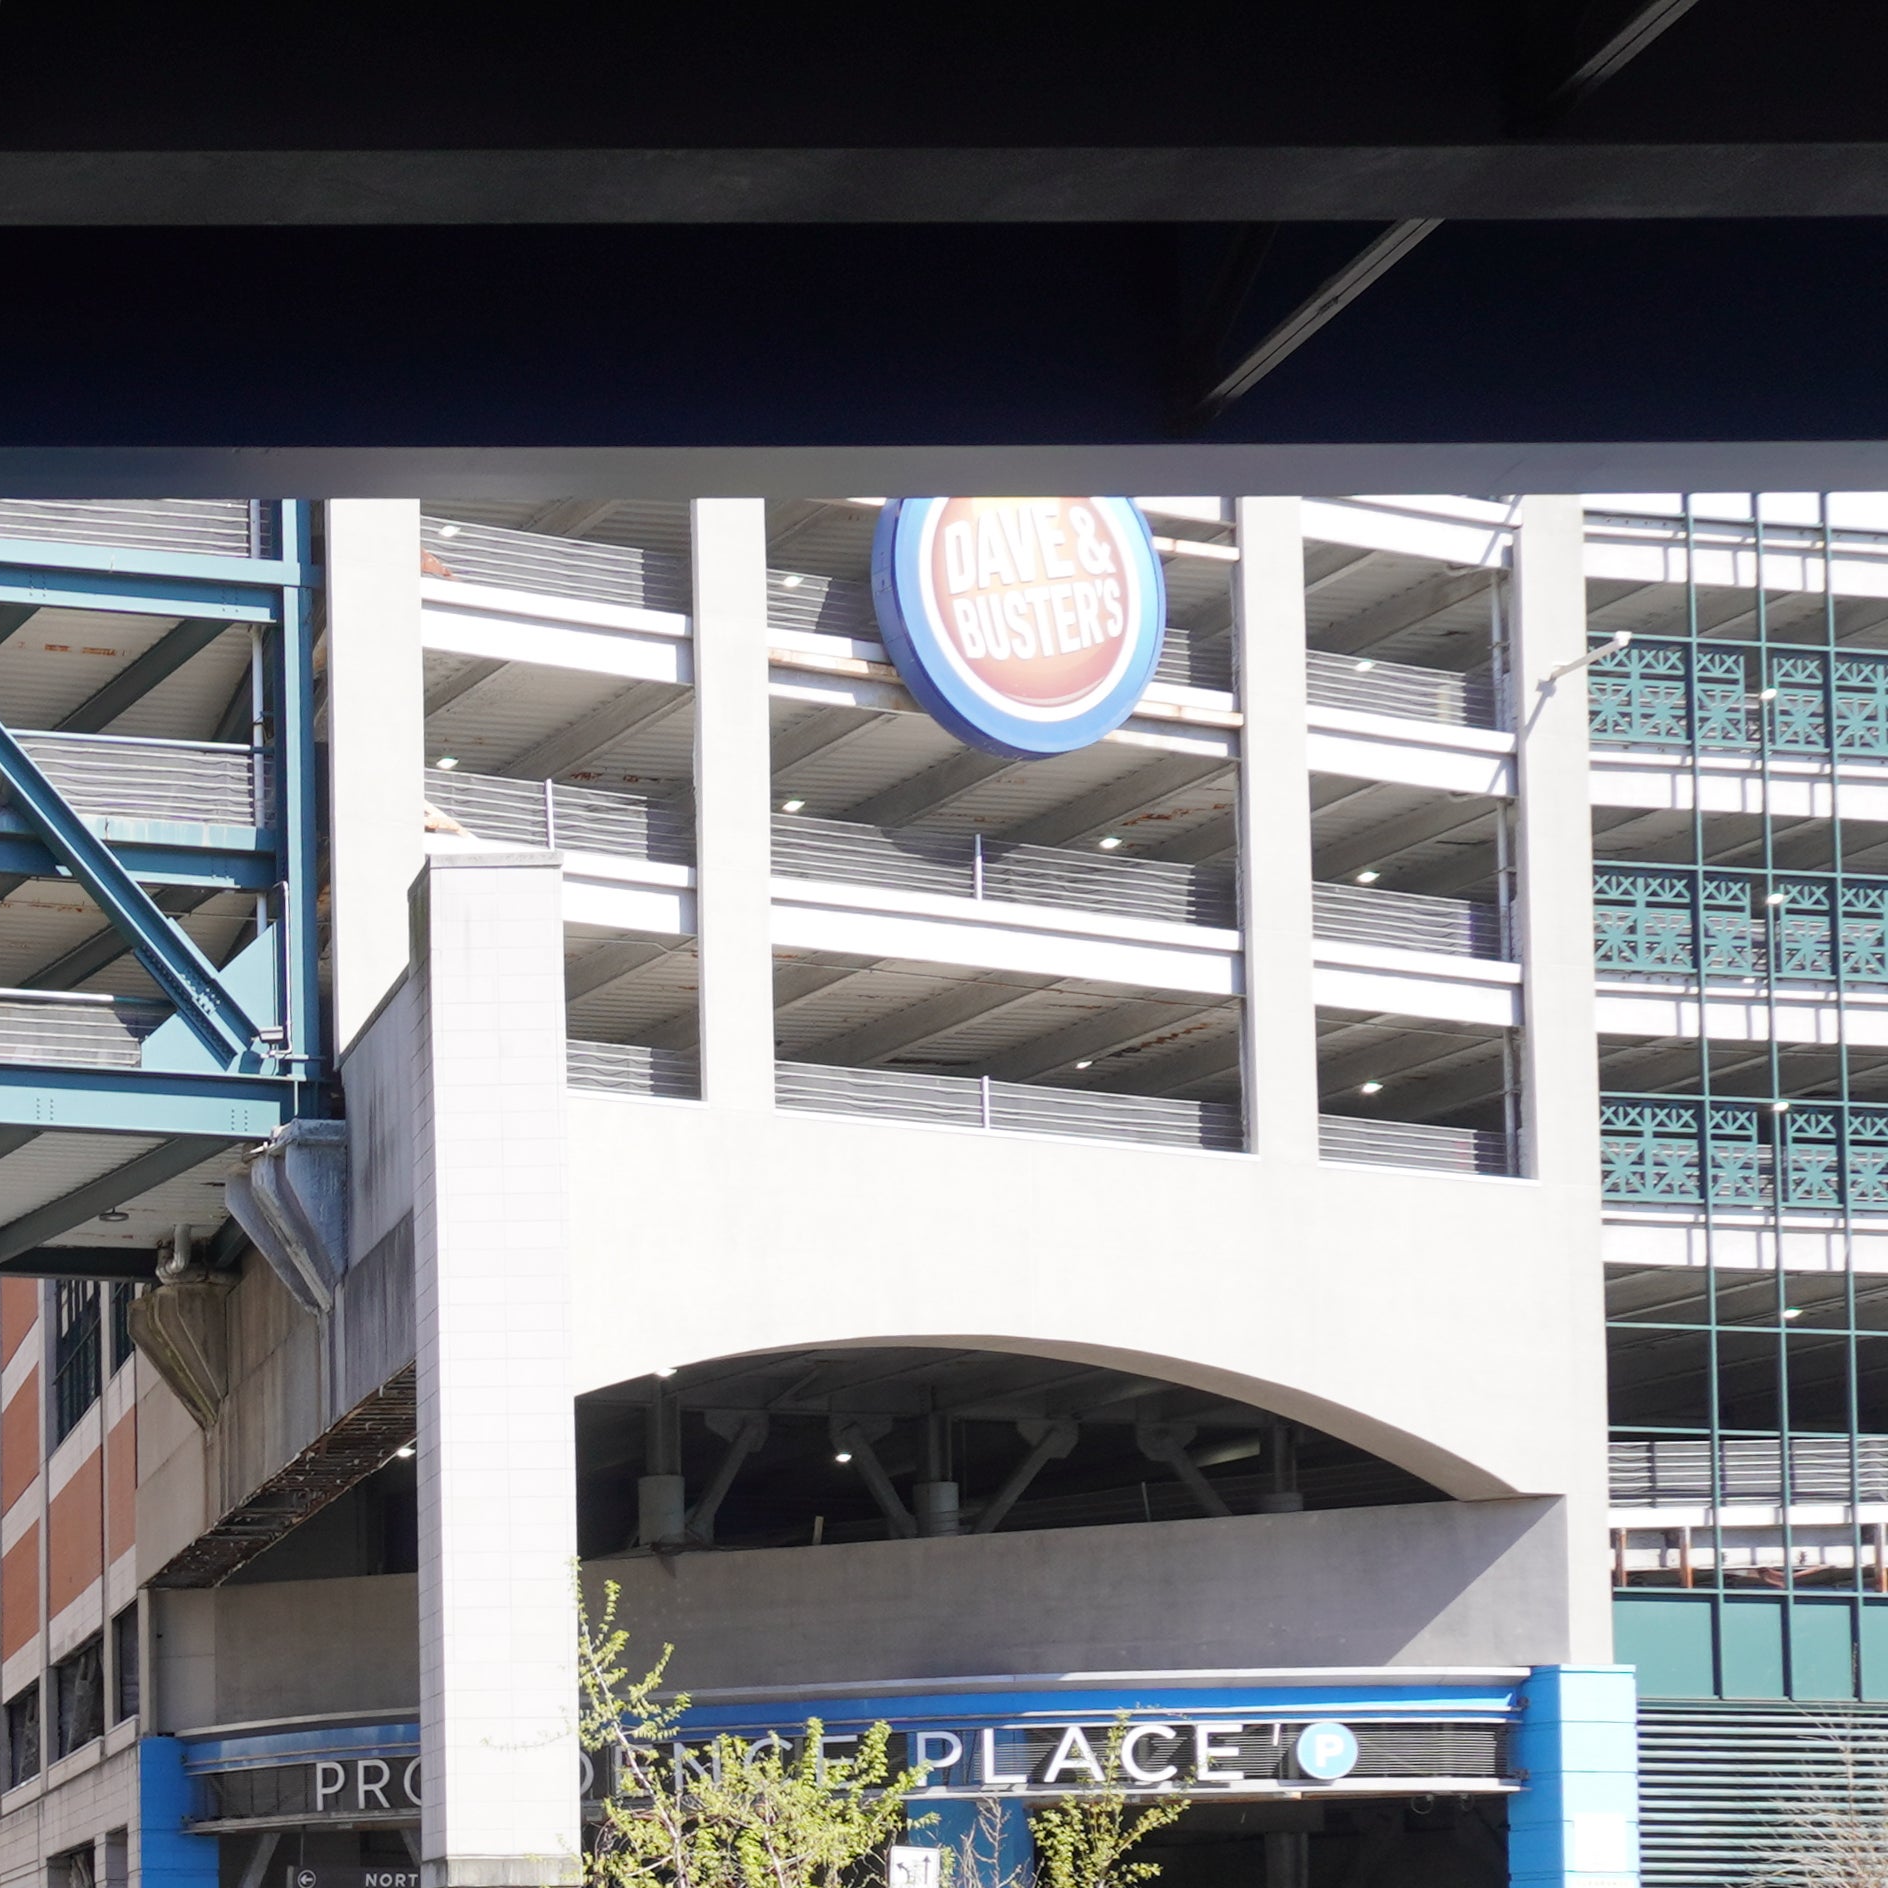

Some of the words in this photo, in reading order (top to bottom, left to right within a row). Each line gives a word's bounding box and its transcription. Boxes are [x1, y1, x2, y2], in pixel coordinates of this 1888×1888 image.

[944, 500, 1073, 595] DAVE
[1068, 505, 1117, 577] &
[953, 578, 1124, 660] BUSTER'S
